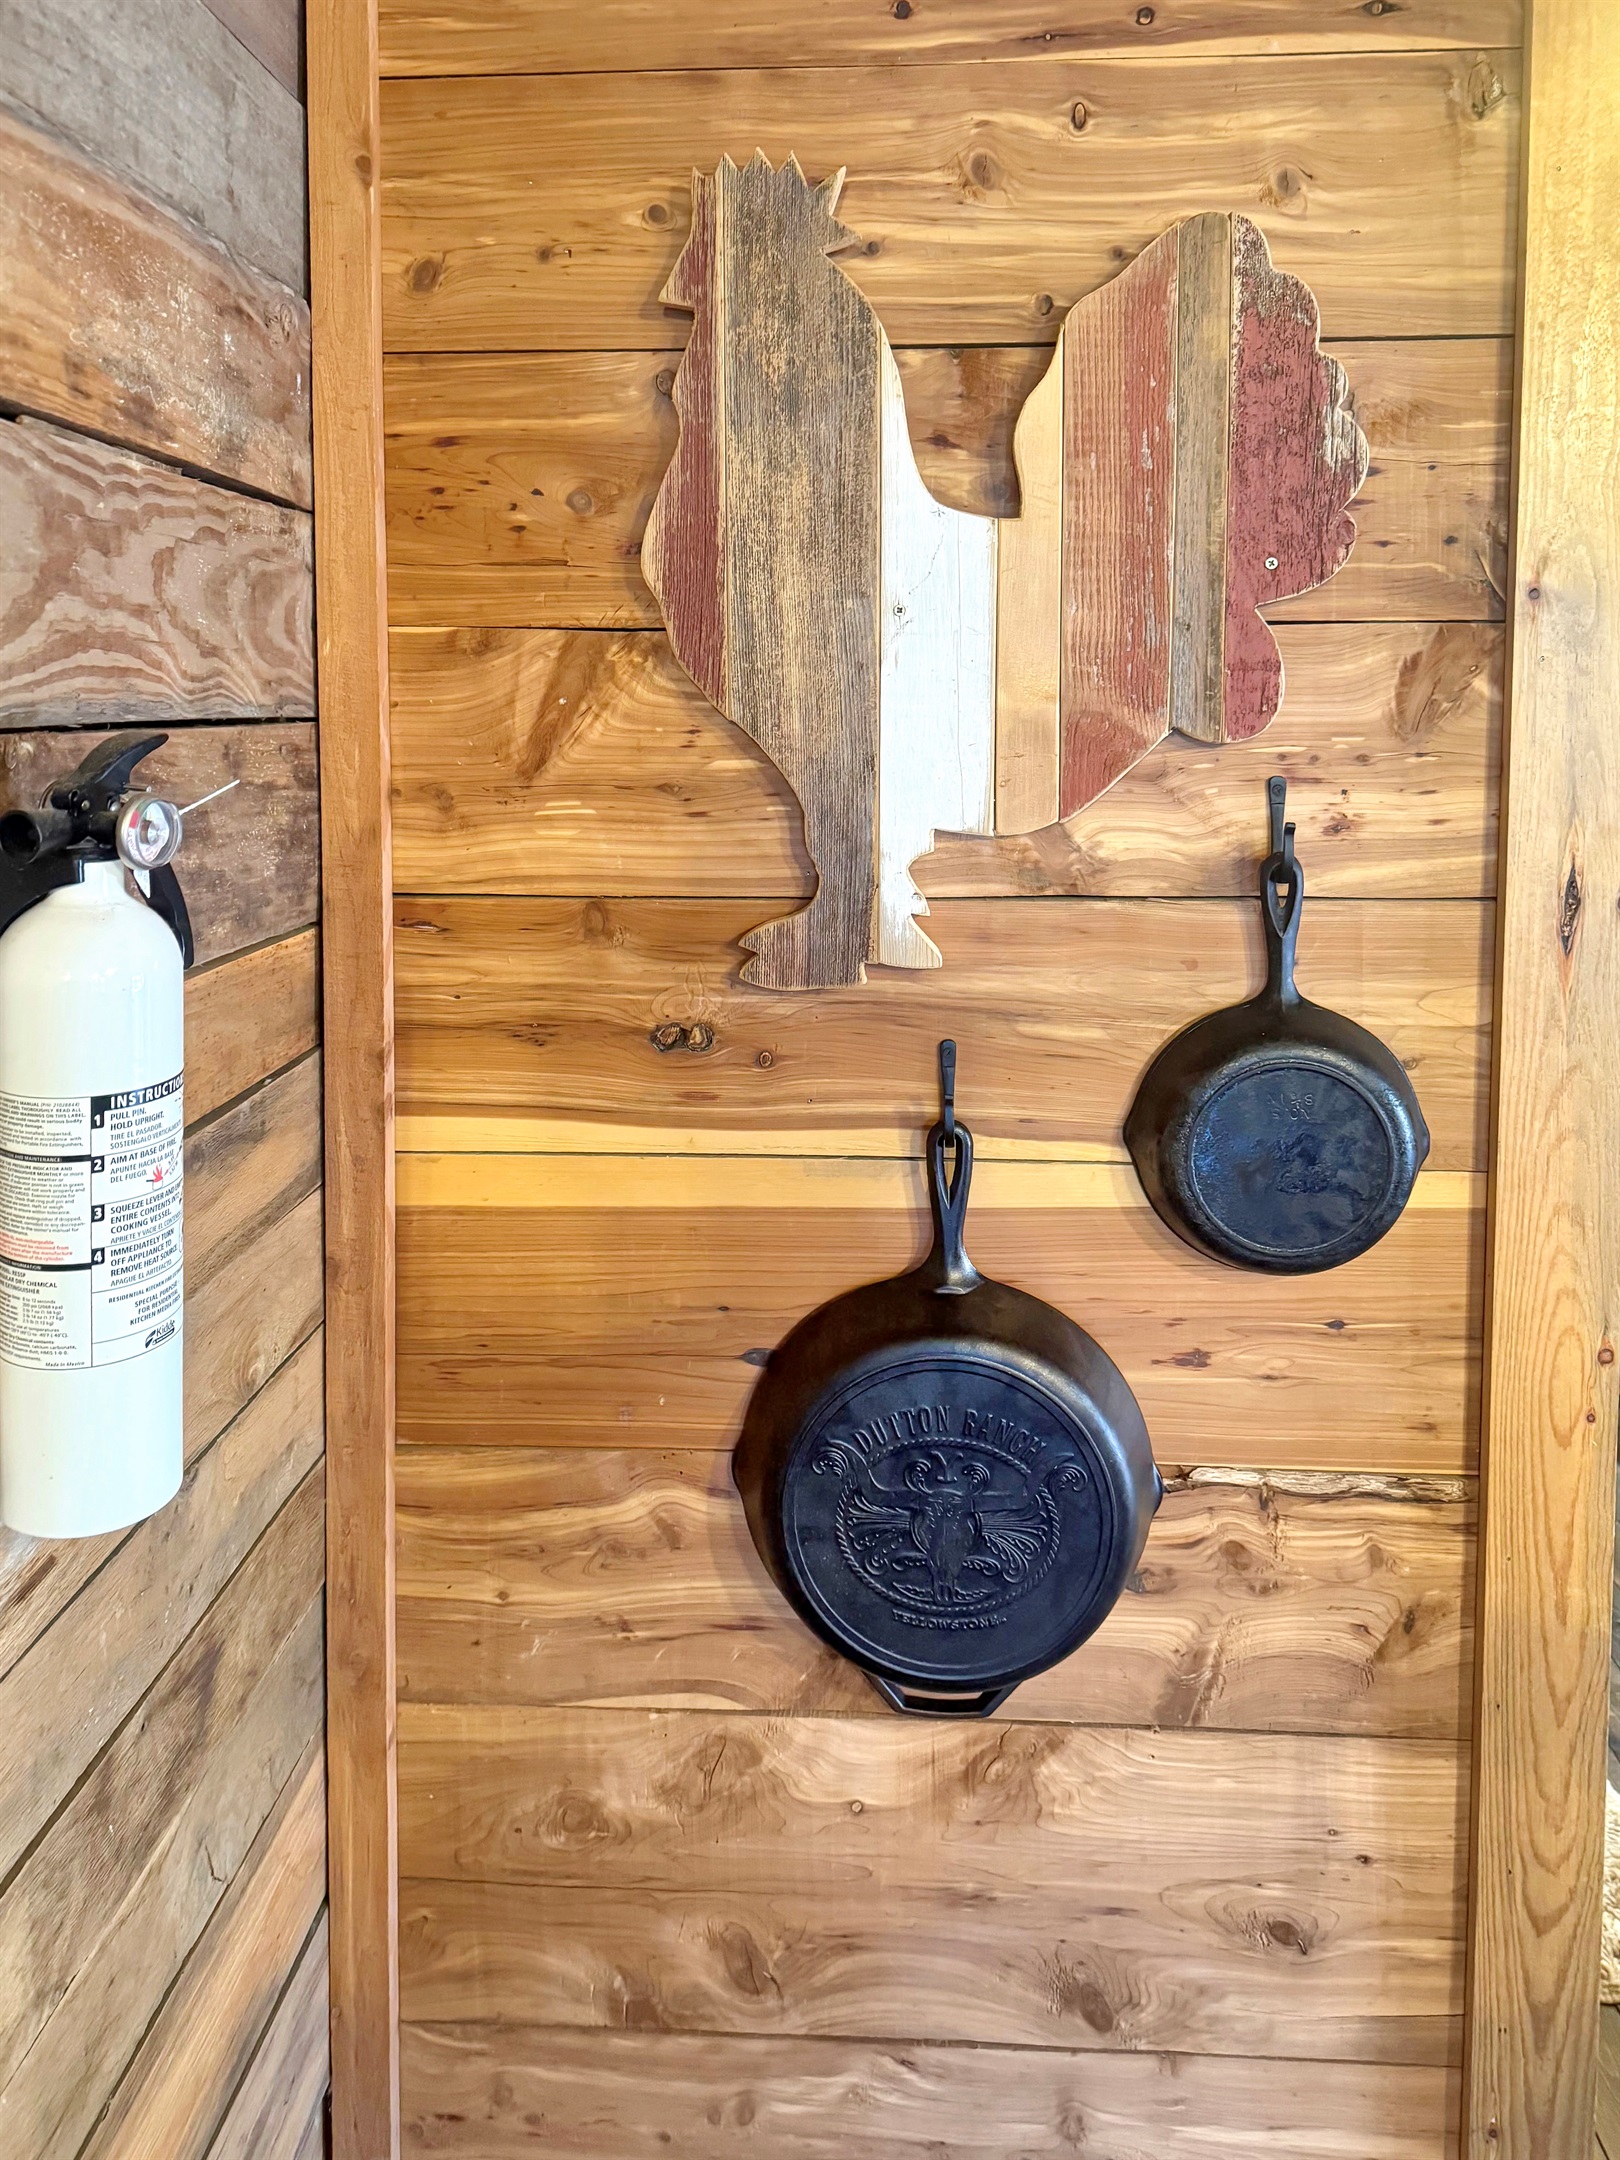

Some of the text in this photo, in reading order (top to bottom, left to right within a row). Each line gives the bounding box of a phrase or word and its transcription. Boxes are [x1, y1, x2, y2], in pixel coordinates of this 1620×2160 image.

[94, 1114, 101, 1127] 1
[110, 1107, 147, 1122] PULL PIN.
[110, 1110, 164, 1131] HOLD UPRIGHT.
[110, 1132, 124, 1141] TIRE
[136, 1122, 162, 1136] PASADOR
[110, 1154, 127, 1165] AIM
[129, 1152, 138, 1162] AT
[140, 1146, 157, 1158] BASE
[159, 1142, 165, 1153] OF
[94, 1160, 102, 1171] 2
[110, 1164, 136, 1175] APUNTE
[110, 1175, 123, 1183] DEL
[110, 1200, 144, 1214] SQUEEZE
[146, 1192, 164, 1205] LEVER
[110, 1198, 171, 1224] ENTIRE CONTENTS
[94, 1208, 102, 1220] 3
[110, 1208, 171, 1234] COOKING VESSEL
[110, 1228, 174, 1257] IMMEDIATELY TURN
[94, 1250, 103, 1262] 4
[110, 1239, 172, 1267] OFF APPLIANCE TO
[110, 1244, 178, 1277] REMOVE HEAT SOURCE
[110, 1276, 137, 1287] APAGUE
[109, 1290, 144, 1303] RESIDENTIAL
[134, 1294, 158, 1308] SPECIAL
[138, 1304, 150, 1314] FOR
[130, 1309, 156, 1326] KITCHEN
[853, 1405, 1046, 1464] DUTTON RANCH
